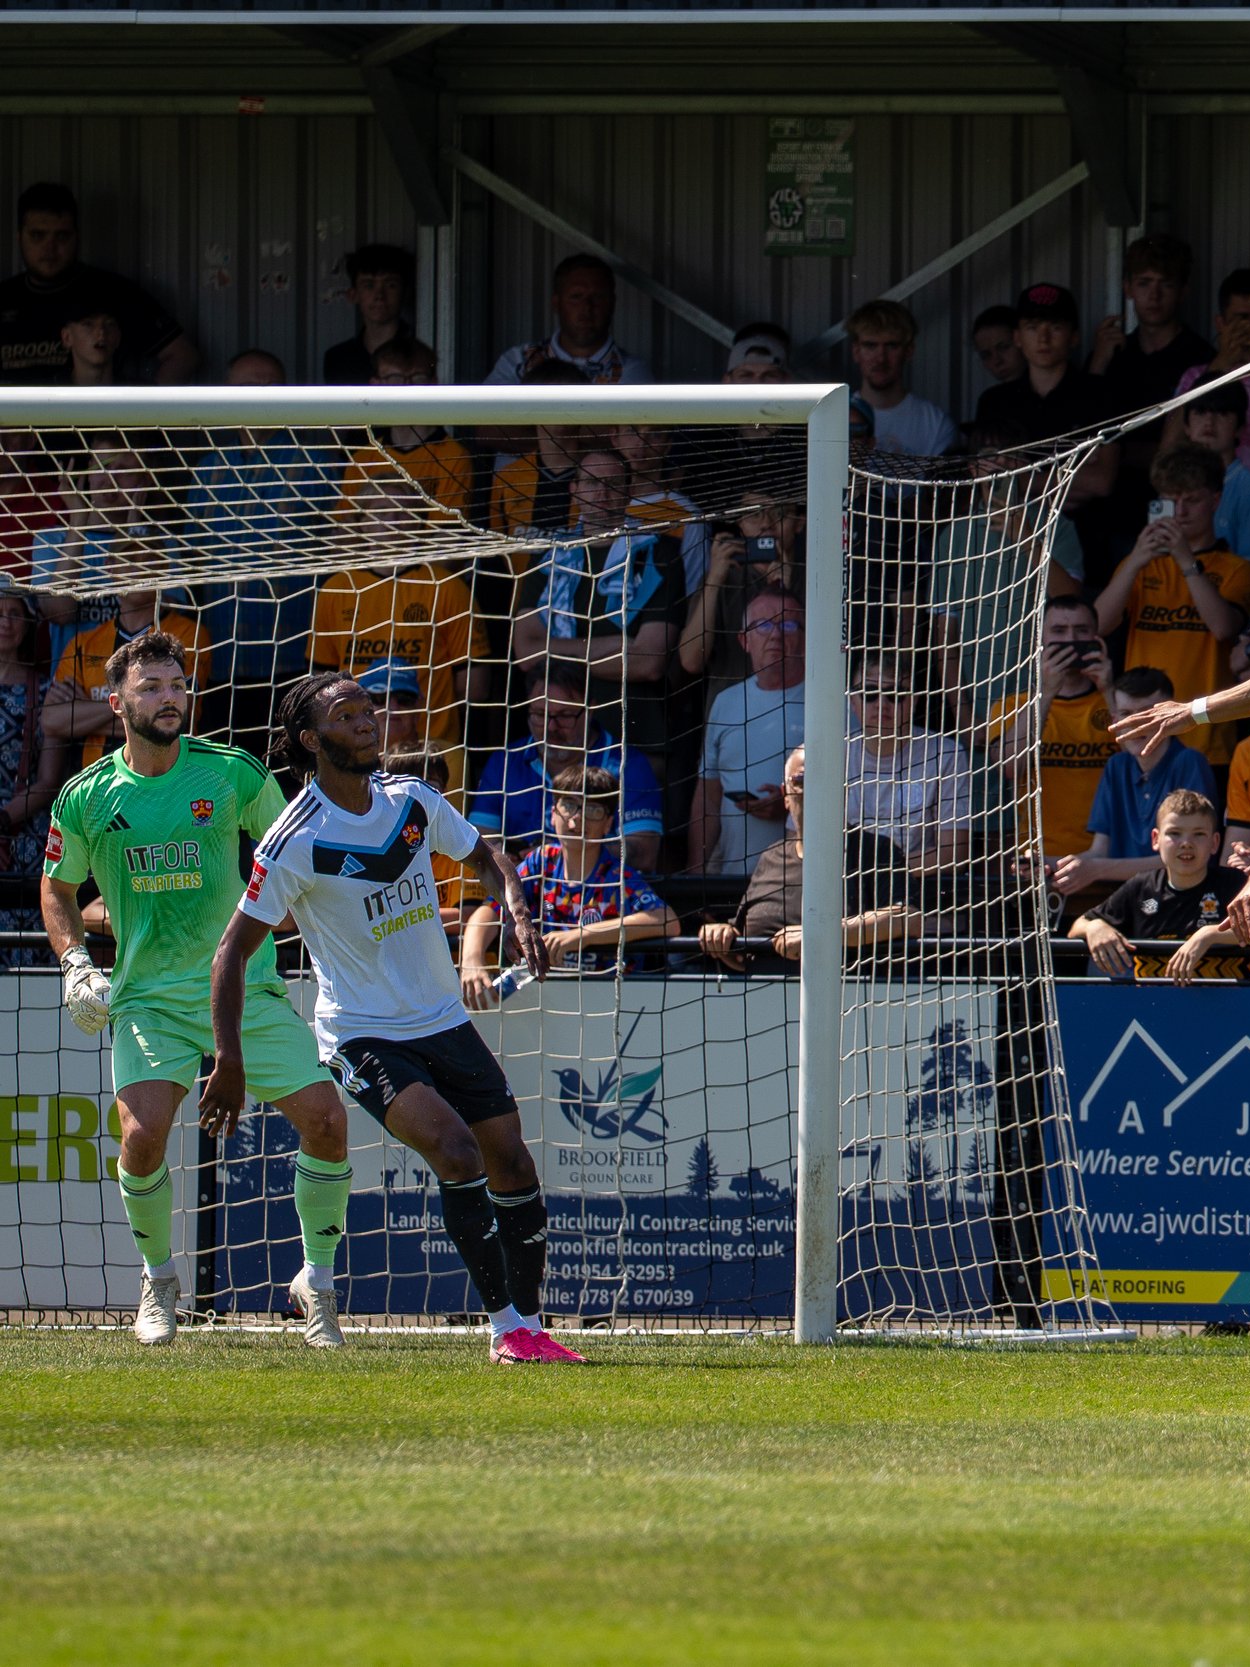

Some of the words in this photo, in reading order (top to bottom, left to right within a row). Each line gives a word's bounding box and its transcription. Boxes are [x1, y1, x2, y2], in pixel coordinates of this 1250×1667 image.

[1140, 604, 1202, 622] BROOK
[624, 807, 664, 822] ENGLA
[131, 872, 204, 893] STARTERS
[371, 902, 435, 942] STARTERS
[1117, 1101, 1145, 1134] A
[1236, 1101, 1249, 1136] J
[558, 1148, 668, 1167] BROOKFIELD
[1078, 1148, 1160, 1175] Where
[389, 1212, 446, 1229] Lands
[546, 1213, 635, 1231] rticultural
[640, 1214, 743, 1237] Contracting
[746, 1215, 797, 1232] Servic
[420, 1239, 458, 1253] ema
[547, 1238, 785, 1260] brookfieldcontracting.co.uk
[561, 1264, 612, 1281] 01954
[538, 1287, 575, 1305] bile:
[633, 1289, 695, 1307] 670039
[1112, 1280, 1186, 1295] ROOFING
